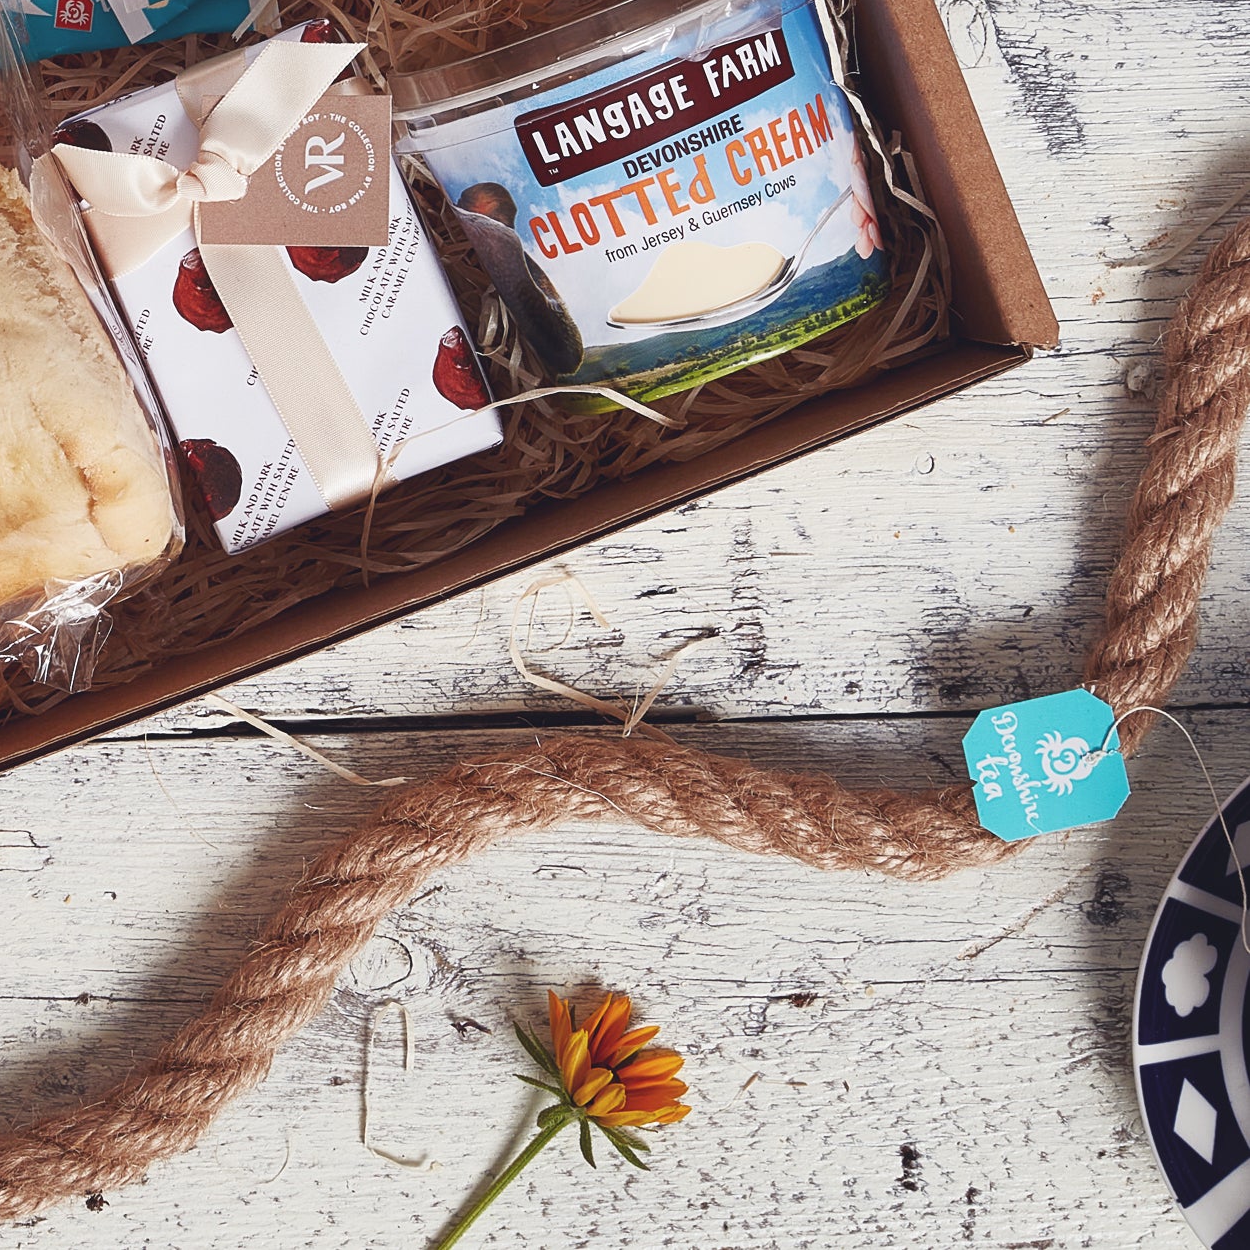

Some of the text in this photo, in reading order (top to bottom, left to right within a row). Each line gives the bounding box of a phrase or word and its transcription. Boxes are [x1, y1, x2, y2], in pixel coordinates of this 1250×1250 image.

[702, 31, 782, 98] FARM
[143, 114, 167, 157] SALTED
[304, 131, 346, 195] VR
[328, 112, 376, 214] THE COLLECTION BY VAN ROY
[622, 113, 745, 179] DEVONSHIRE
[725, 93, 835, 187] CREAM
[274, 153, 301, 205] COLLECTION
[301, 202, 319, 214] THE
[604, 173, 797, 263] from Jersey & Guernsey Cows
[359, 276, 377, 303] MILK
[372, 248, 387, 273] AND
[359, 268, 394, 336] CHOCOLATE
[388, 237, 407, 266] WITH
[381, 222, 421, 319] CARAMEL CENTRE
[379, 388, 410, 452] ITH SALTED
[395, 415, 414, 442] NTRE
[230, 461, 274, 547] MILK AND DARK
[259, 483, 278, 511] WITH
[273, 438, 296, 481] SALTED
[275, 465, 300, 509] CENTRE
[976, 753, 1008, 801] tea
[990, 711, 1043, 834] Devonshire
